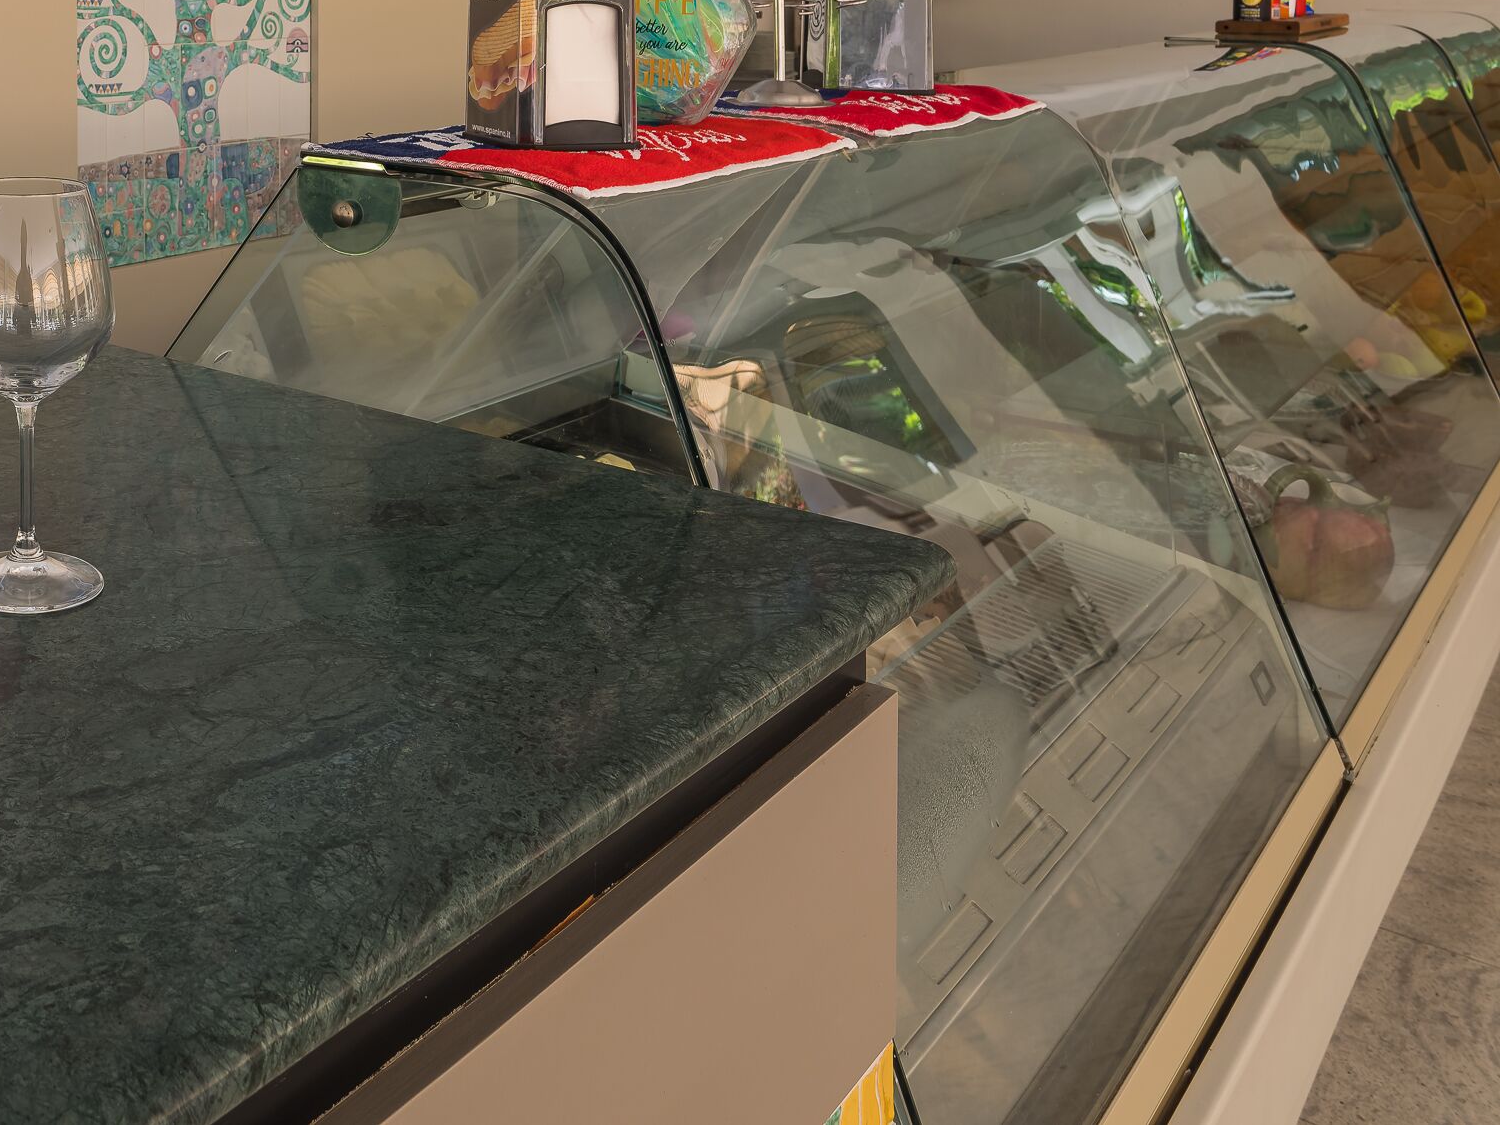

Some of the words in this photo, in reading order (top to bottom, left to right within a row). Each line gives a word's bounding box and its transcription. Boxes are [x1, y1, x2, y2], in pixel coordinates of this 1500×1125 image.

[635, 18, 669, 36] better
[639, 39, 664, 56] you
[665, 40, 688, 51] are
[635, 58, 701, 90] GHING
[471, 124, 511, 139] www.spanino.it
